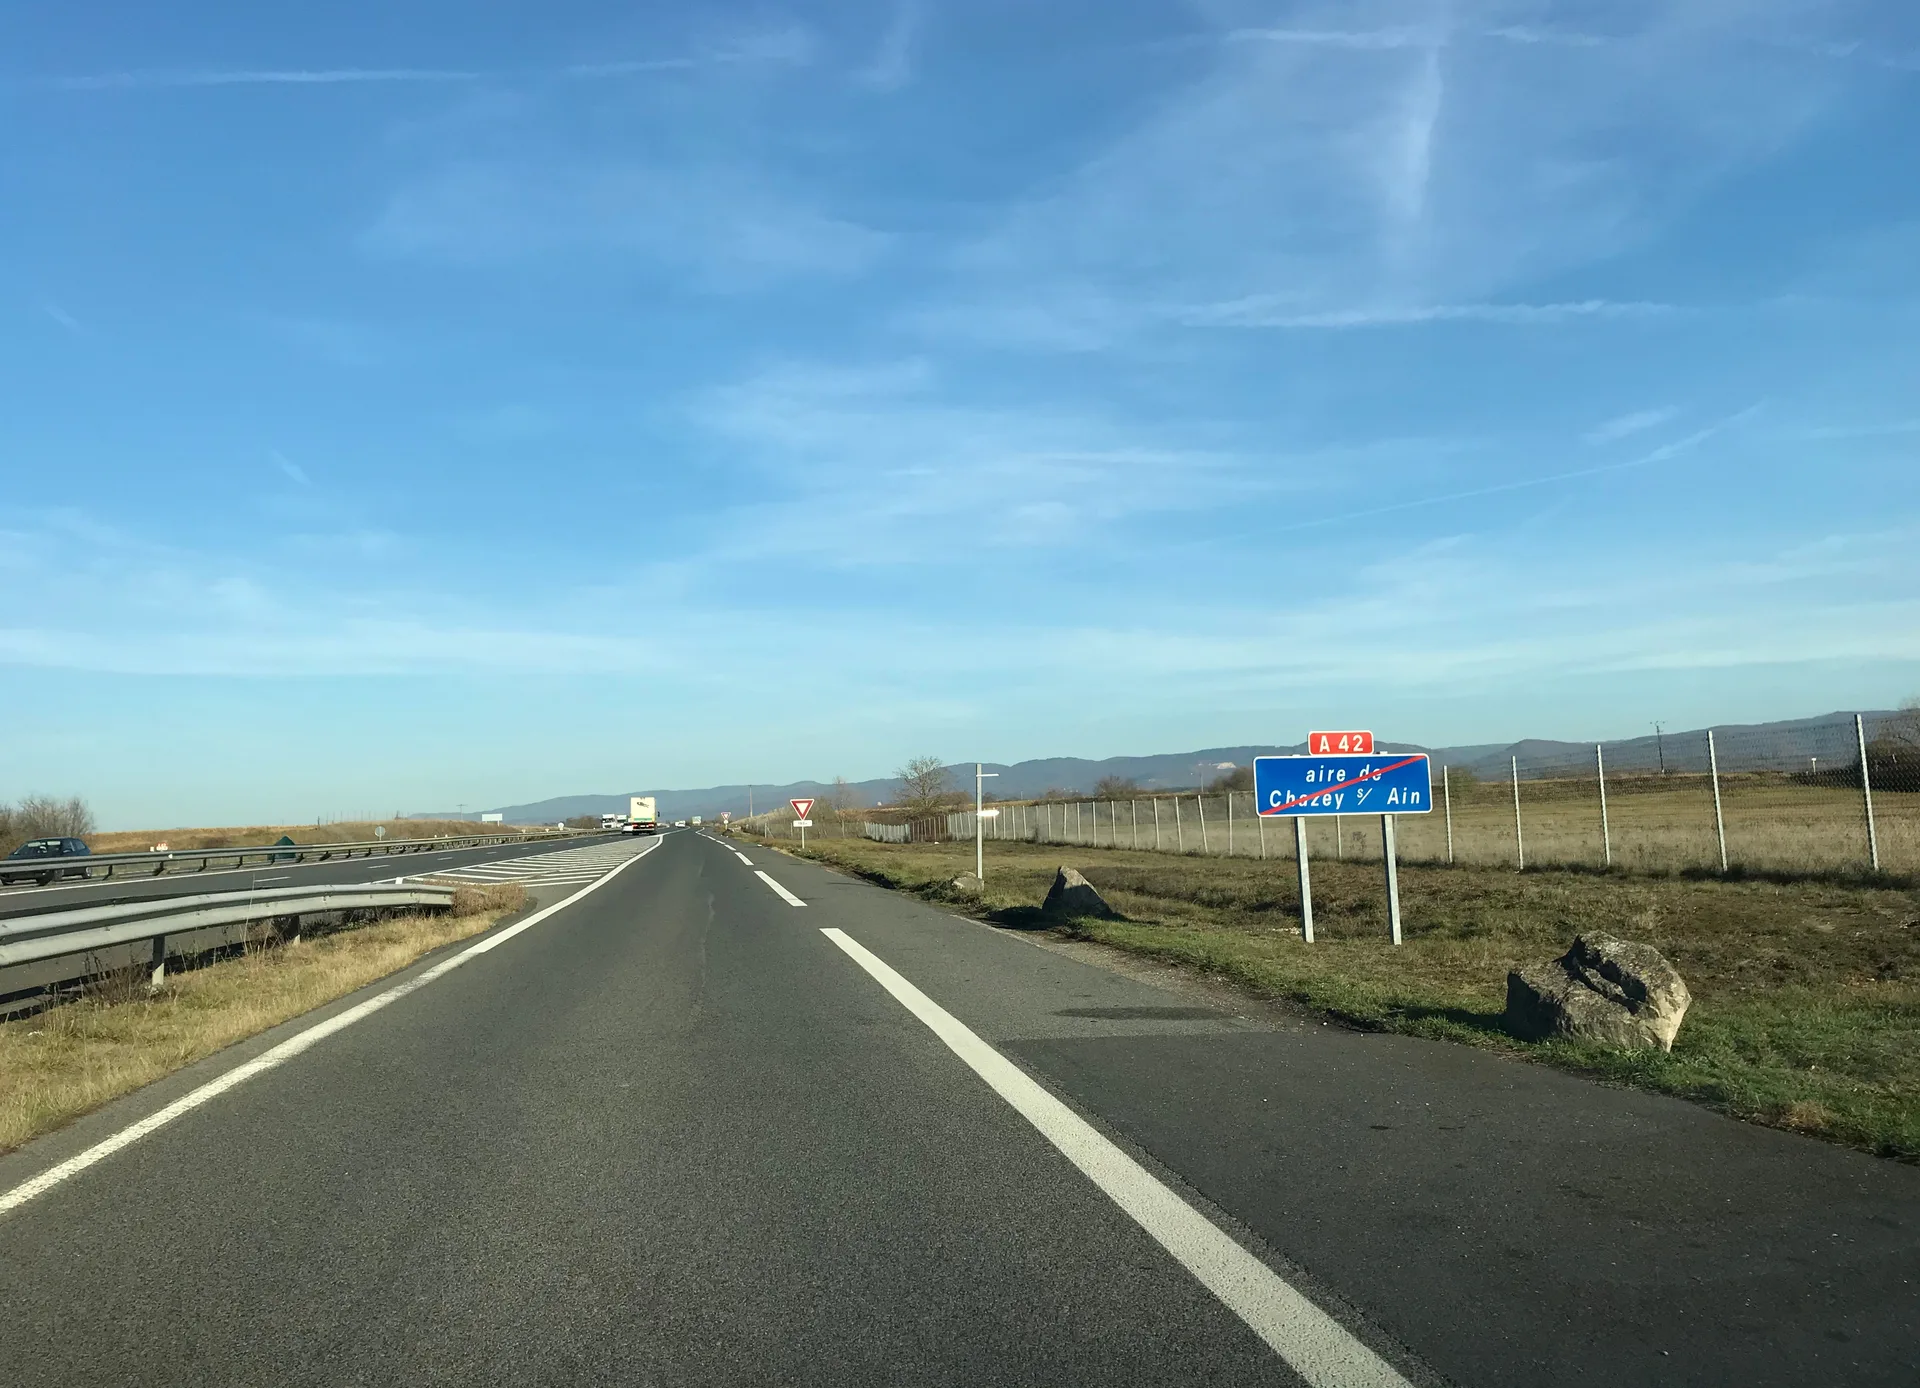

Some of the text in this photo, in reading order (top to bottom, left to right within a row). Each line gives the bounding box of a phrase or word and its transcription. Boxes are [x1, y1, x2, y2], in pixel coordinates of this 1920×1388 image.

[1319, 735, 1363, 752] A 42
[1306, 764, 1382, 782] aire de
[1269, 789, 1344, 809] Chazey
[1387, 787, 1420, 804] Ain
